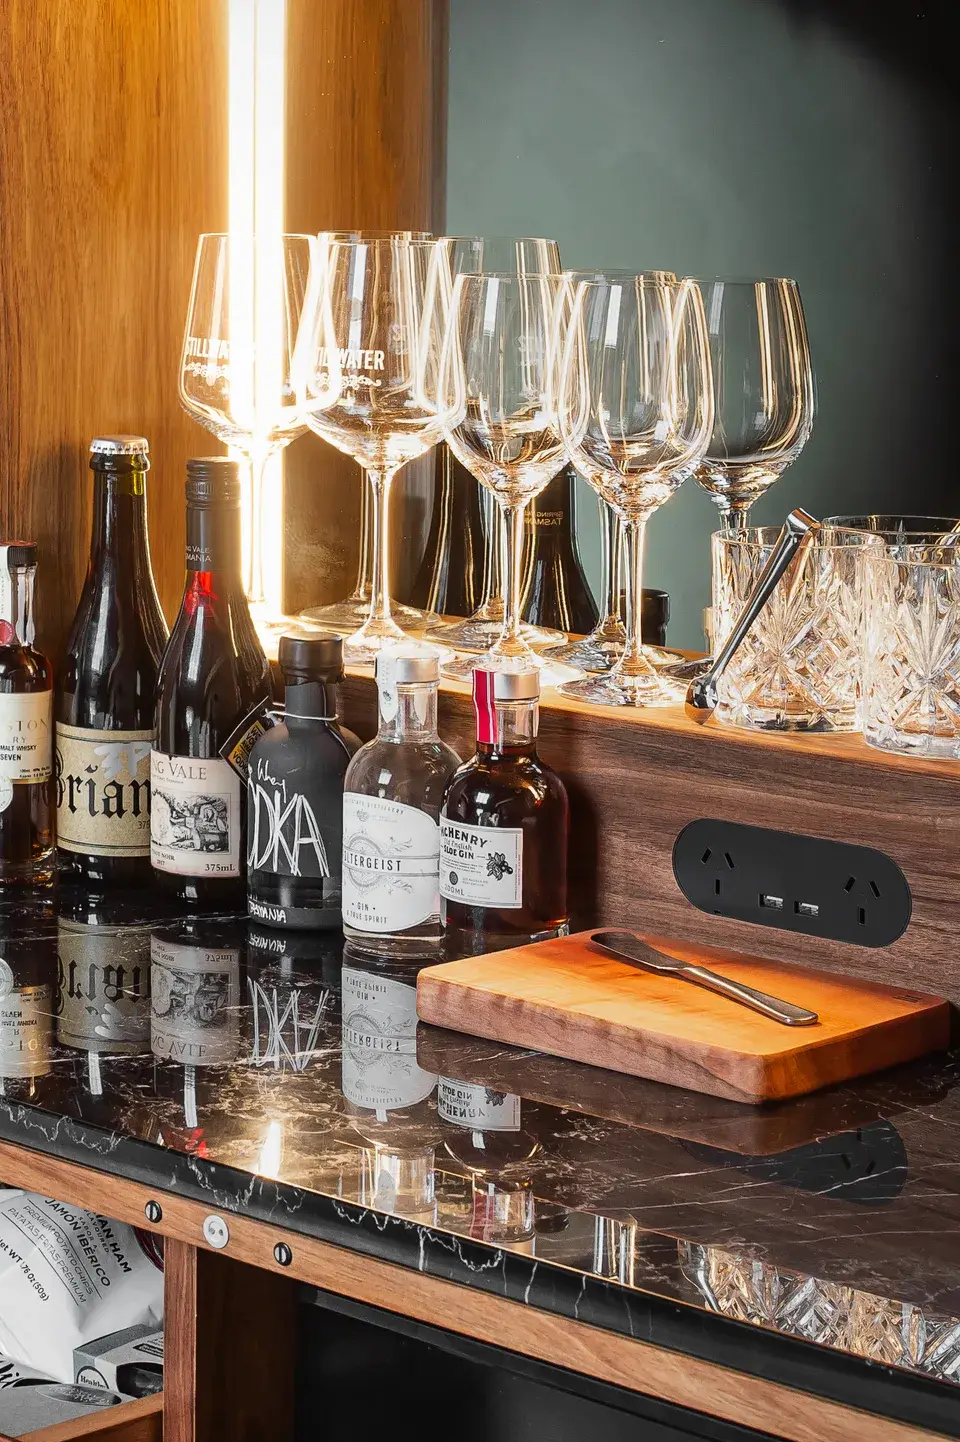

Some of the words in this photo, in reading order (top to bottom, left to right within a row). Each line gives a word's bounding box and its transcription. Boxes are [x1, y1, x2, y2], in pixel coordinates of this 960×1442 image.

[0, 753, 22, 761] SEVEN
[169, 762, 207, 780] VALE
[444, 845, 457, 857] SLOE
[458, 849, 474, 860] GIN
[205, 863, 236, 872] 375mL
[357, 902, 369, 912] GIN
[351, 911, 362, 921] TRUE
[365, 914, 387, 924] SPIRIT
[23, 1205, 54, 1235] PREMIUM
[53, 1231, 77, 1267] POTATO
[74, 1264, 93, 1295] CHIPS
[45, 1199, 81, 1231] JAMÓN
[77, 1233, 111, 1288] IBÉRICO
[8, 1207, 40, 1240] PATATAS
[38, 1235, 60, 1262] FRITAS
[56, 1260, 87, 1303] PREMIUM
[110, 1240, 132, 1274] HAM
[8, 1248, 23, 1264] WT
[27, 1272, 36, 1283] Oz
[32, 1280, 50, 1302] (50g)
